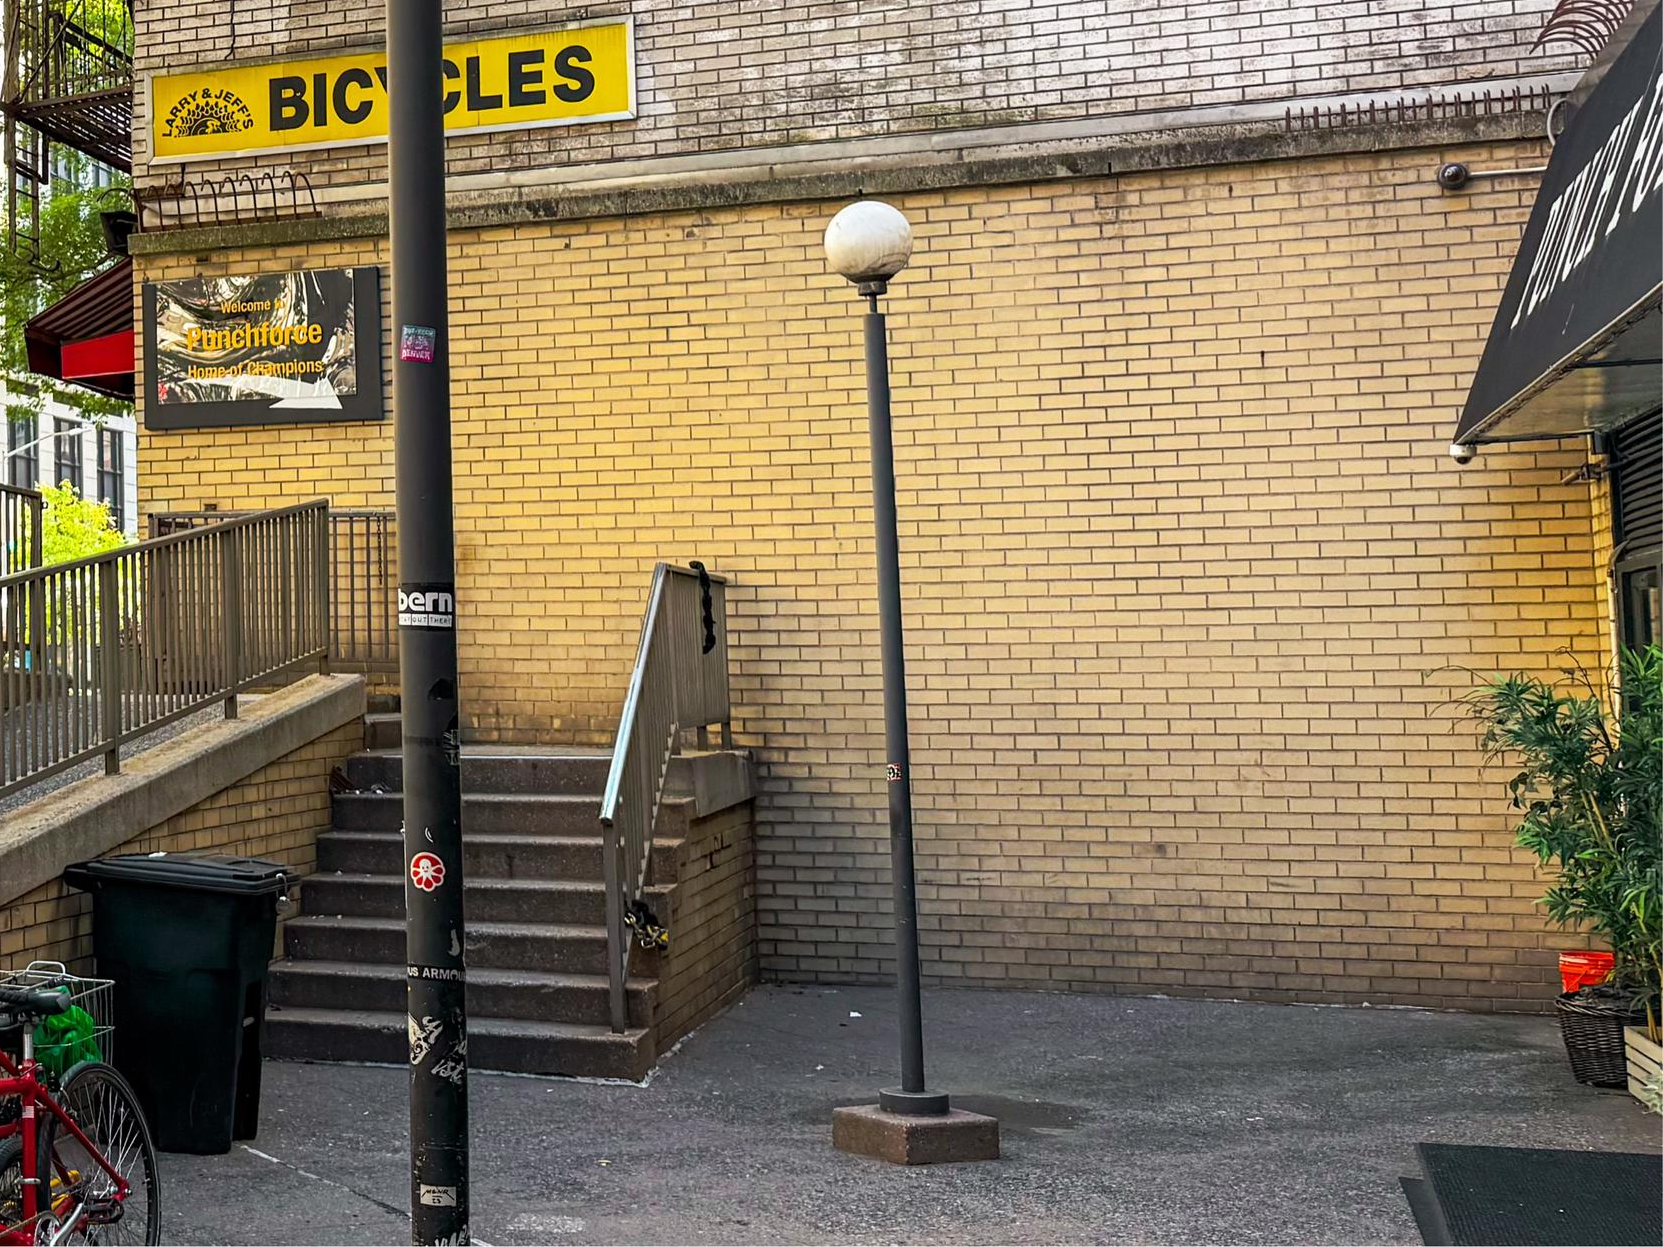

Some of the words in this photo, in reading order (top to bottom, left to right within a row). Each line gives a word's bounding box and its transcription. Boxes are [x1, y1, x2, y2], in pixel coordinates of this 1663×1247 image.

[269, 45, 595, 132] BICLES
[162, 90, 198, 137] LARRY
[201, 88, 213, 99] &
[214, 89, 254, 130] JEFF'S
[1510, 95, 1644, 331] PUNCH
[221, 300, 271, 315] Welcome
[187, 321, 323, 352] Punchforce
[188, 364, 226, 381] Home
[229, 362, 243, 376] of
[248, 359, 323, 378] Champions
[398, 588, 453, 612] bern
